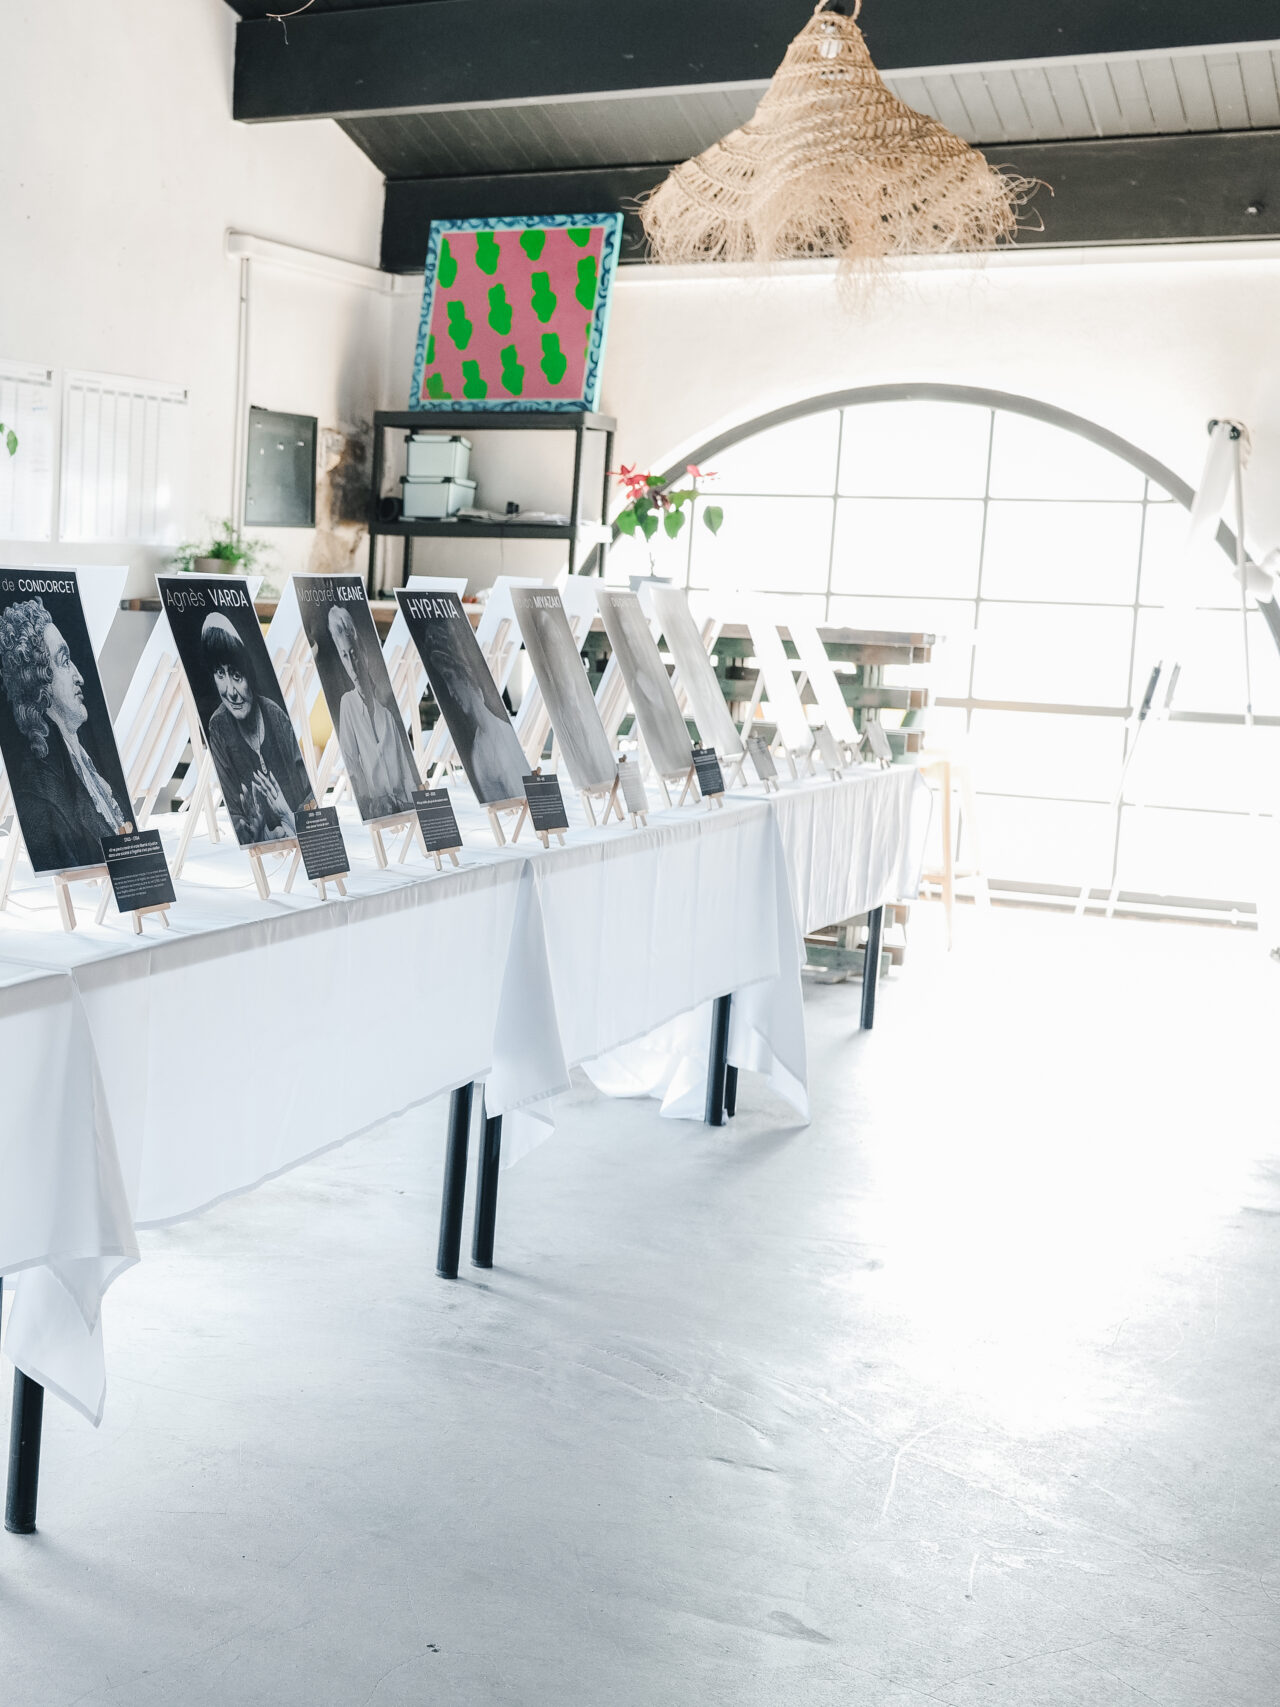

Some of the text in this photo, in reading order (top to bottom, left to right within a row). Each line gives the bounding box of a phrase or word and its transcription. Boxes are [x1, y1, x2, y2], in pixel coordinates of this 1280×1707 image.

[2, 578, 15, 592] de
[18, 579, 75, 594] CONDORCET
[336, 586, 365, 601] KEANE
[166, 587, 250, 613] Agnès VARDA
[406, 598, 461, 620] HYPATIA
